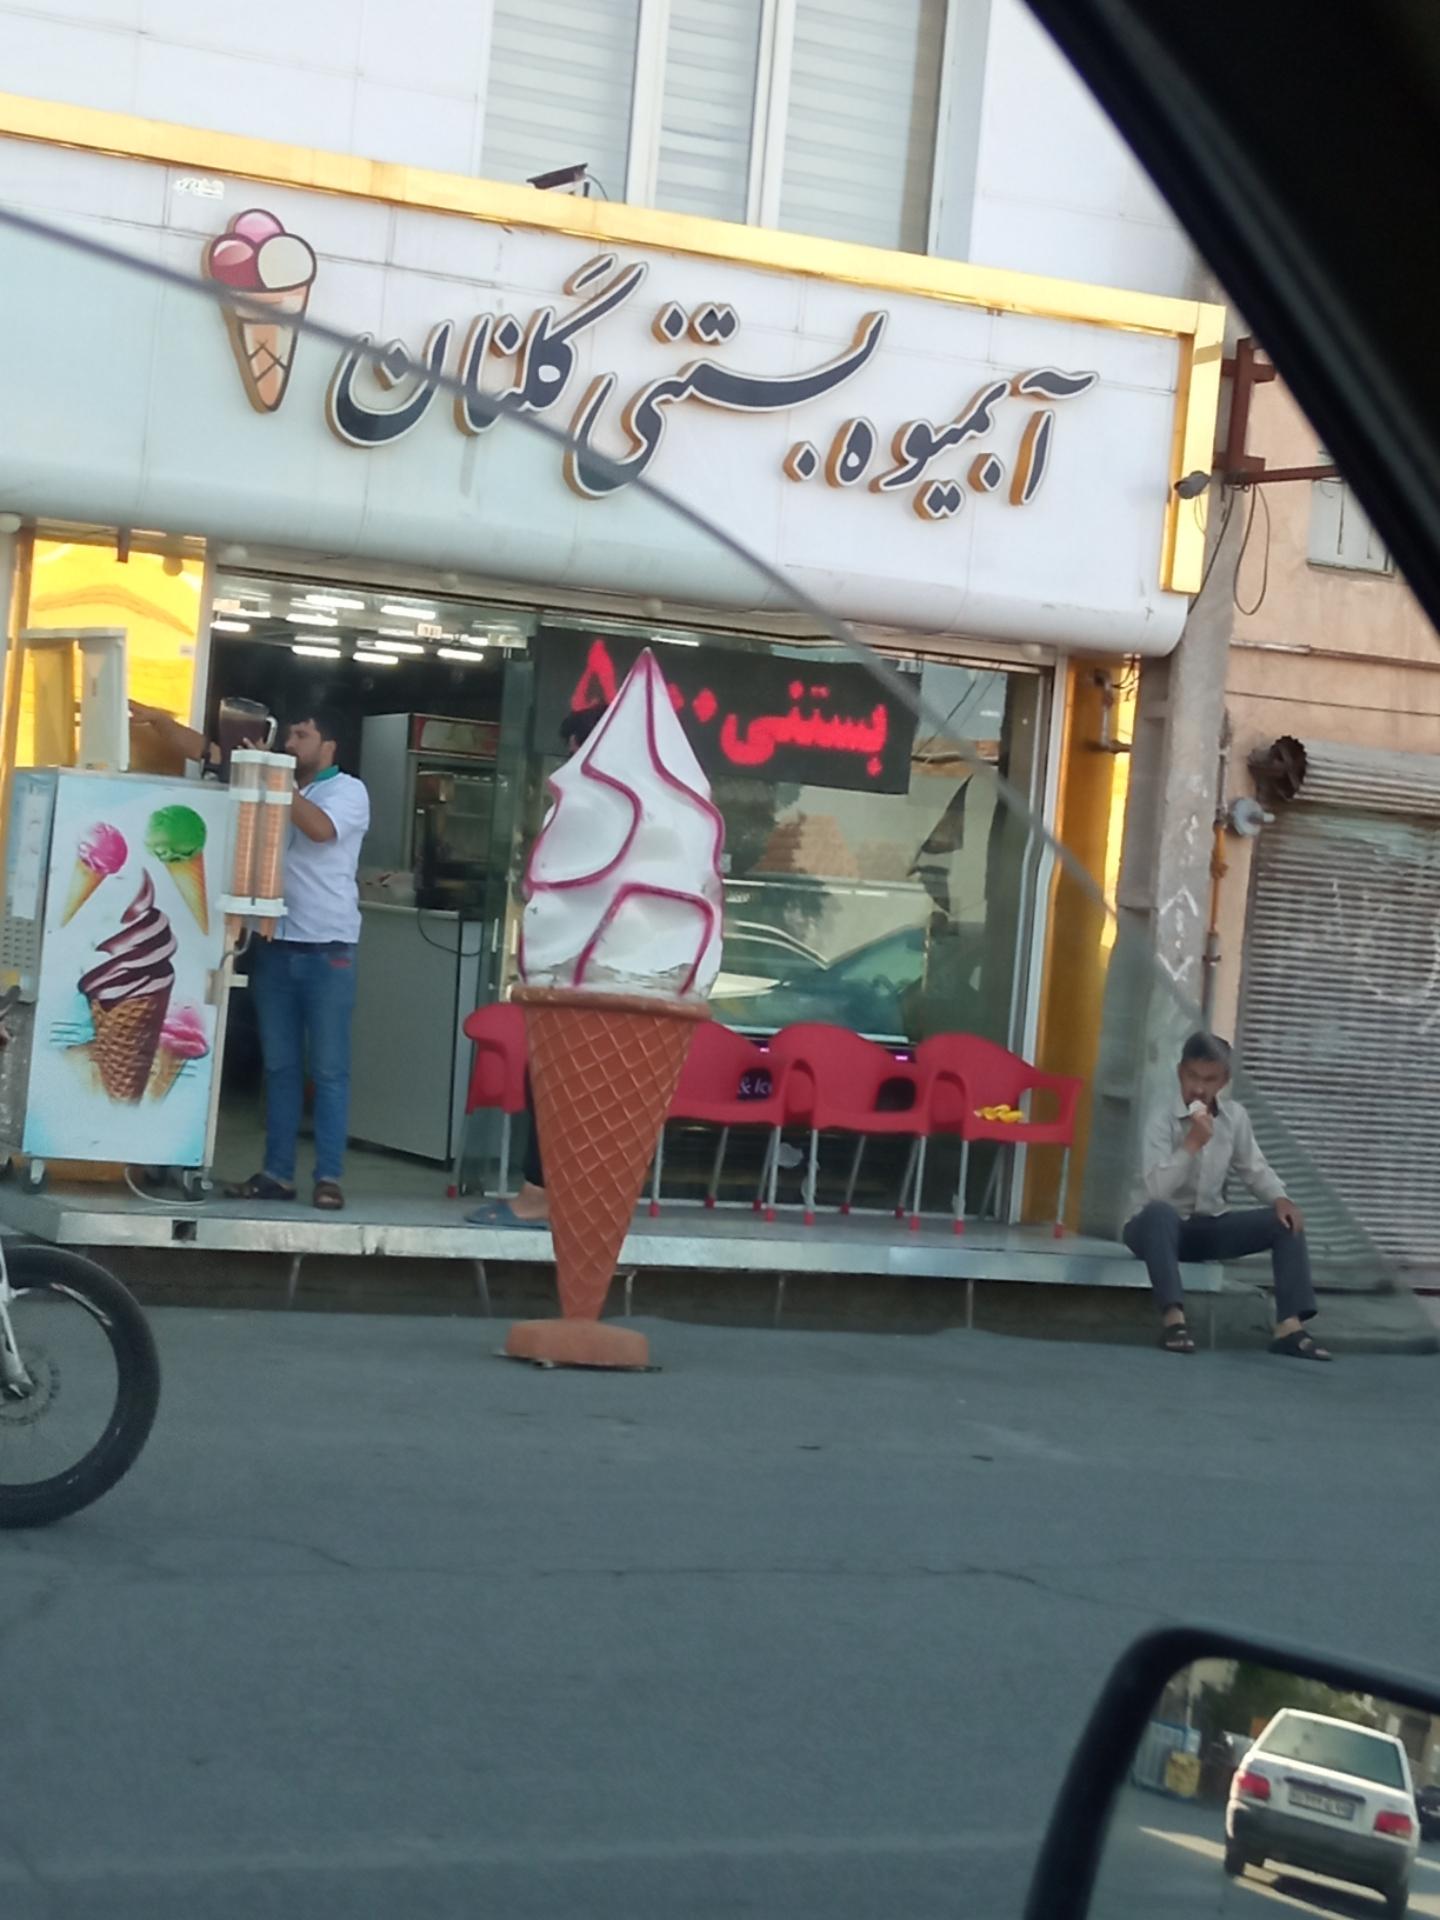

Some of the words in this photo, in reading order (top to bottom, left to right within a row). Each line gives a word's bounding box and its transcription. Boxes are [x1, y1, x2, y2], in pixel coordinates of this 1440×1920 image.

[563, 302, 888, 500] بستنی
[826, 366, 1100, 521] آبمیوه
[720, 679, 889, 778] بستنی
